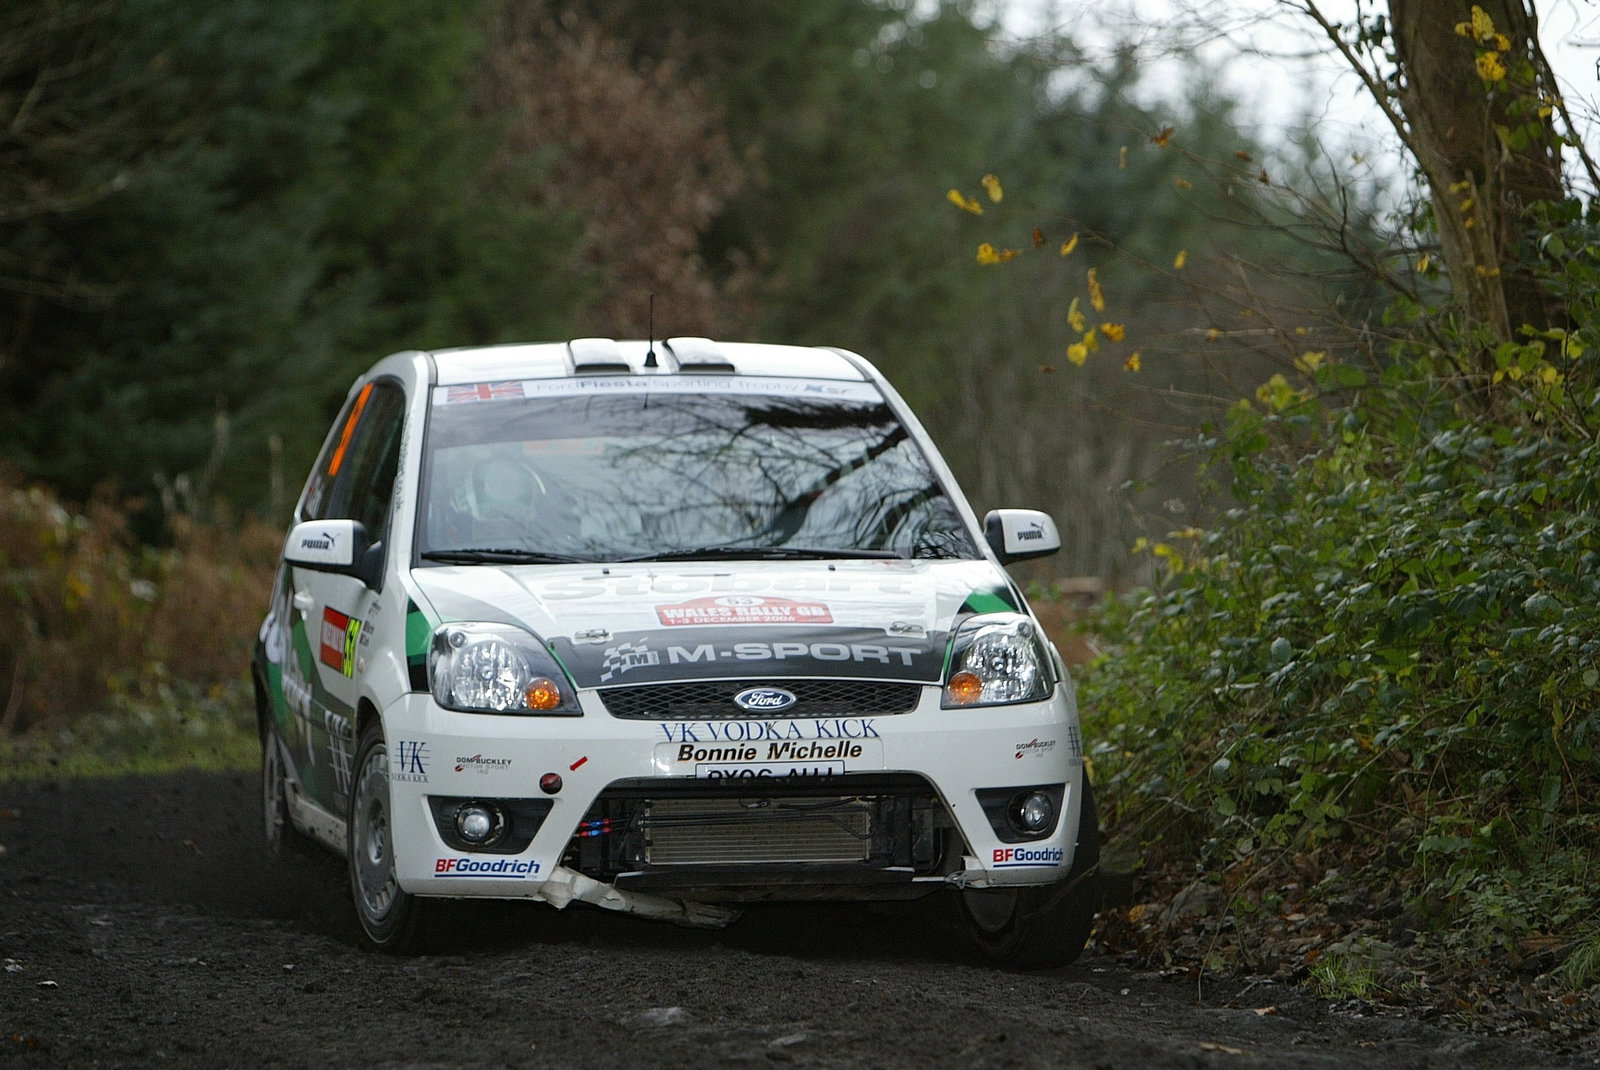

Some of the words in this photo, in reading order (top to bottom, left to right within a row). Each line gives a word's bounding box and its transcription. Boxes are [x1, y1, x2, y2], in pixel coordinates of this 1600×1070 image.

[739, 380, 799, 392] Trophy
[1017, 530, 1043, 541] PUMA
[301, 539, 330, 549] PUMA
[662, 606, 729, 618] WALES
[735, 605, 791, 617] RALLY
[796, 604, 826, 616] GB
[669, 617, 690, 625] 1-3
[693, 616, 764, 624] DECEMBER
[765, 615, 796, 623] 2006
[667, 643, 922, 666] M-SPORT
[748, 691, 784, 707] Ford
[660, 722, 702, 743] VK
[706, 720, 804, 741] VODKA
[815, 718, 881, 738] KICK
[399, 740, 427, 774] VK
[677, 743, 757, 761] Bonnie
[766, 741, 862, 760] Michelle
[475, 757, 512, 766] BUCKLEY
[992, 848, 1063, 863] BFGoodrich
[435, 858, 541, 873] BFGoodrich
